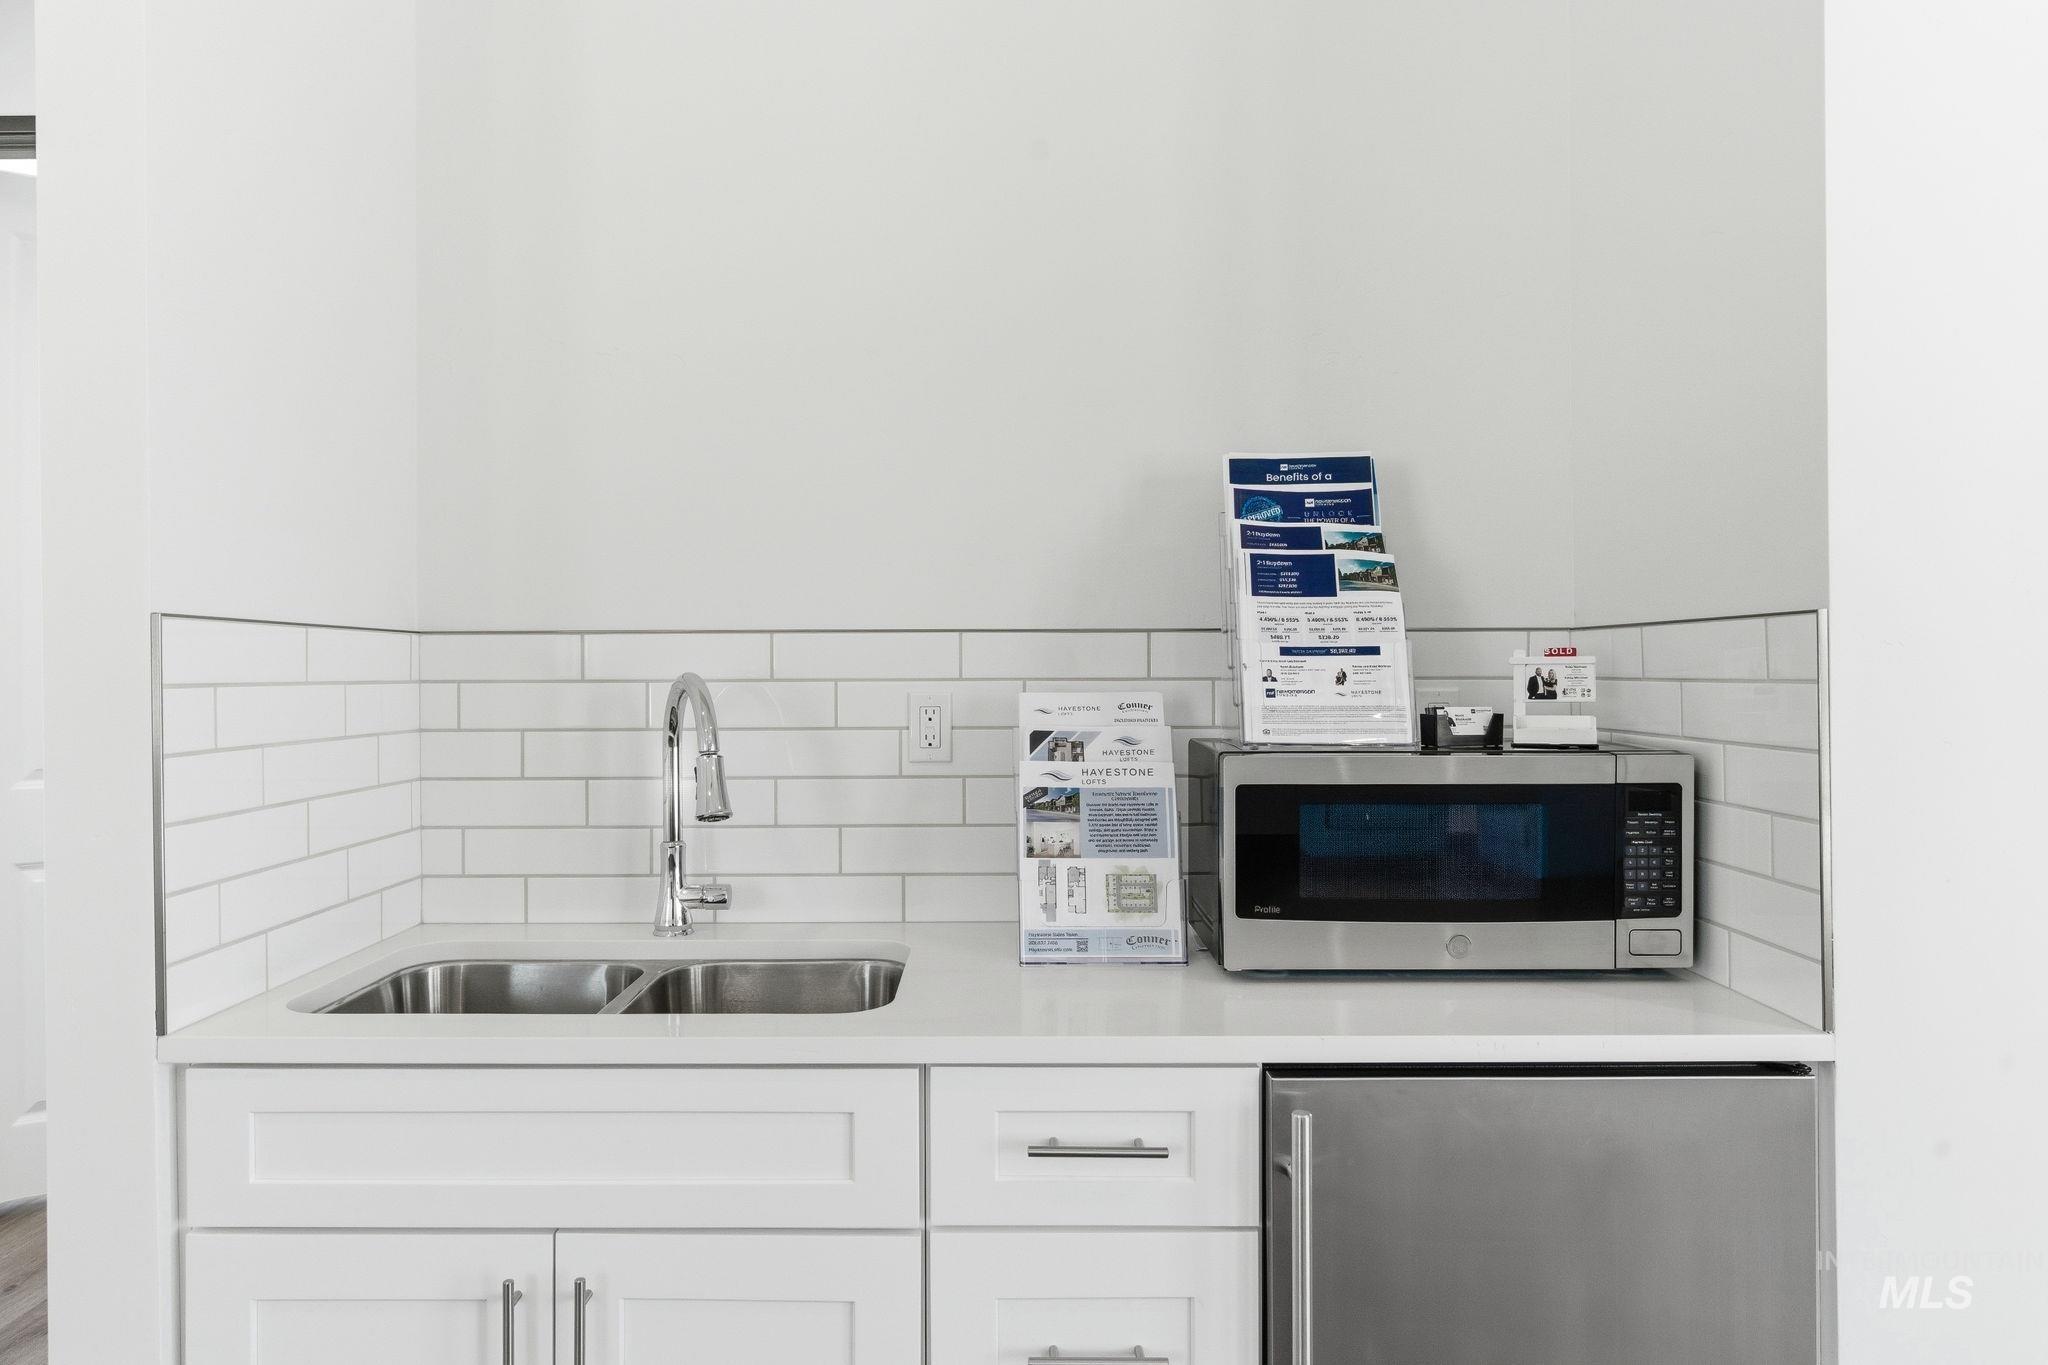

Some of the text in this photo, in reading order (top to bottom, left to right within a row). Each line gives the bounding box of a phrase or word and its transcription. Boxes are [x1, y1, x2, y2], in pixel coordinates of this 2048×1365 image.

[1266, 472, 1332, 482] Benefits of a
[1544, 647, 1573, 655] SOLD
[1081, 768, 1154, 777] HAYESTONE
[1254, 905, 1281, 914] Profile
[1125, 935, 1171, 946] Conner
